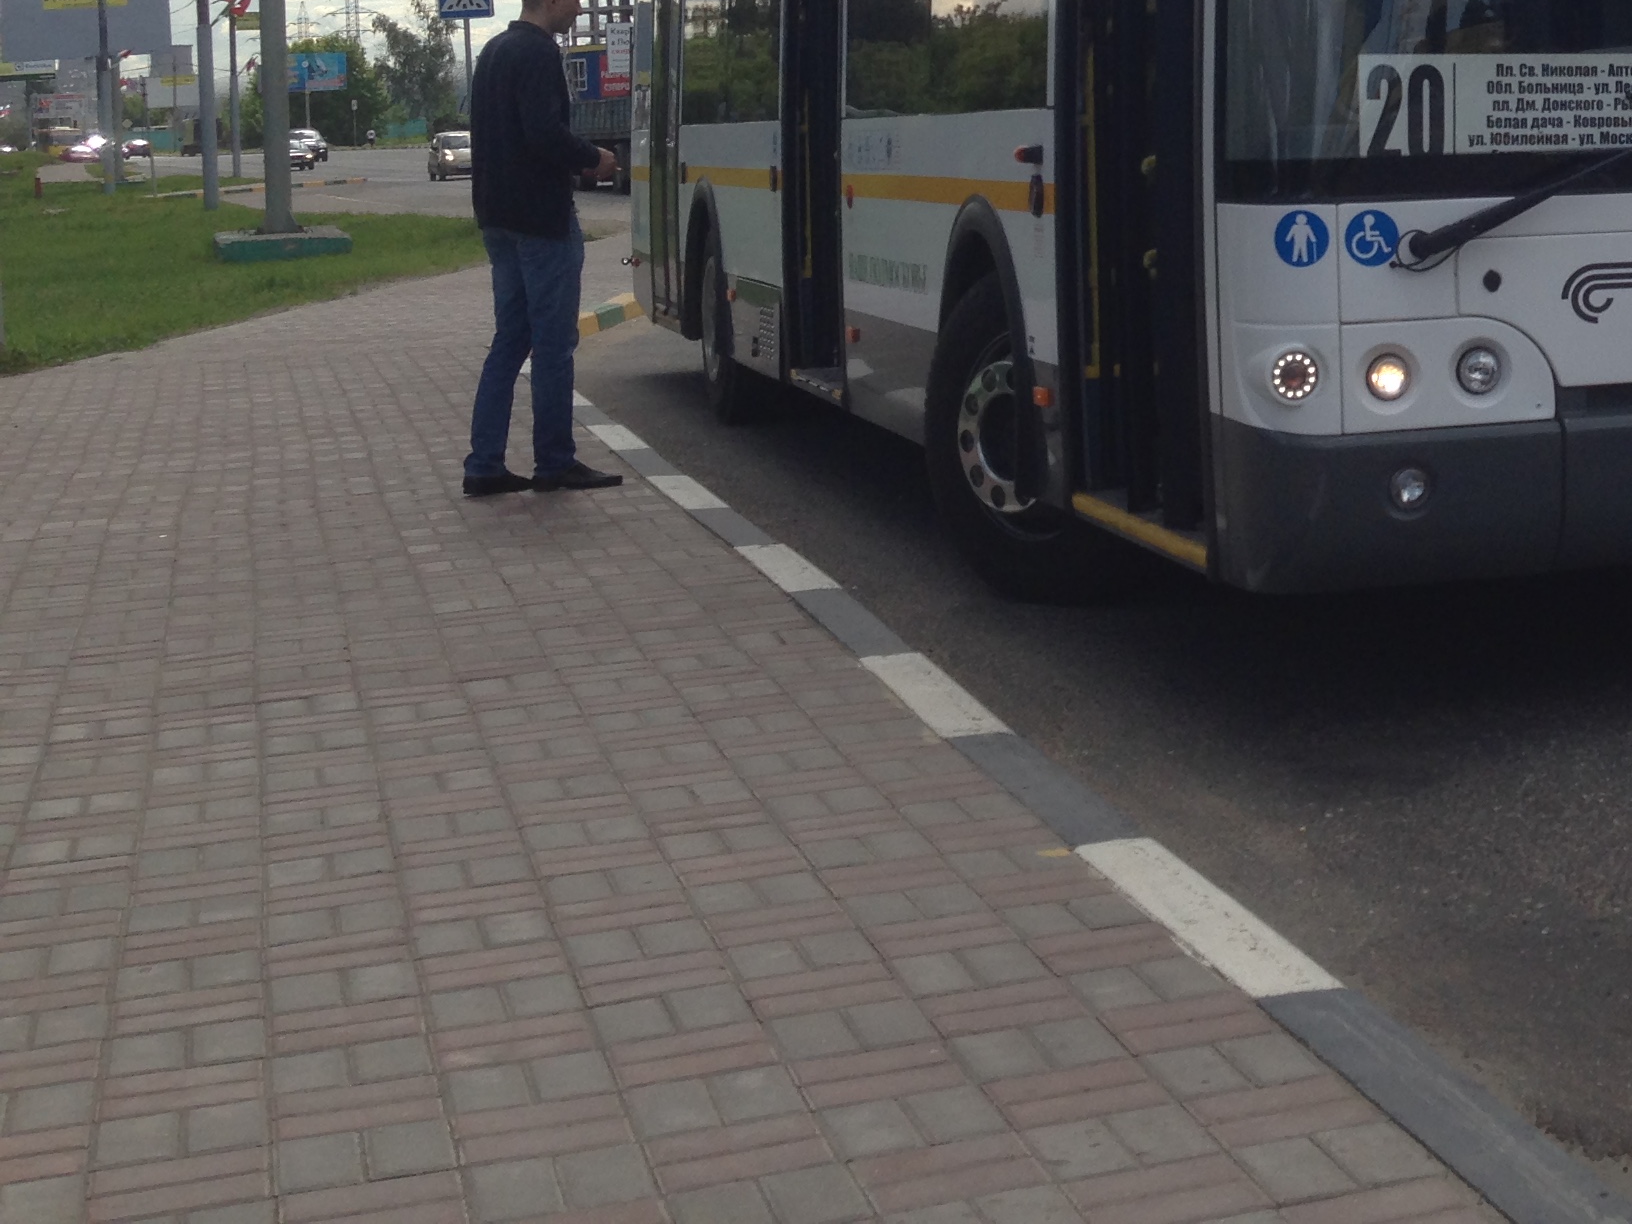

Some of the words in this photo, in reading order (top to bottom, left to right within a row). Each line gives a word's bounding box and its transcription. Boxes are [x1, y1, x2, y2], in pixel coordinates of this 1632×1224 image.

[1496, 64, 1517, 77] Пл.
[1519, 64, 1539, 77] Св.
[1542, 64, 1598, 77] Николая
[1487, 81, 1515, 94] Обл.
[1518, 81, 1584, 96] Больница
[1594, 83, 1612, 95] ул.
[1367, 64, 1444, 156] 20
[1493, 100, 1513, 112] пл.
[1515, 98, 1539, 113] Дм.
[1542, 98, 1604, 112] Донского
[1487, 115, 1528, 128] Белая
[1531, 117, 1563, 129] дача
[1468, 134, 1487, 147] ул.
[1491, 131, 1569, 146] Юбилейная
[1579, 133, 1597, 146] ул.
